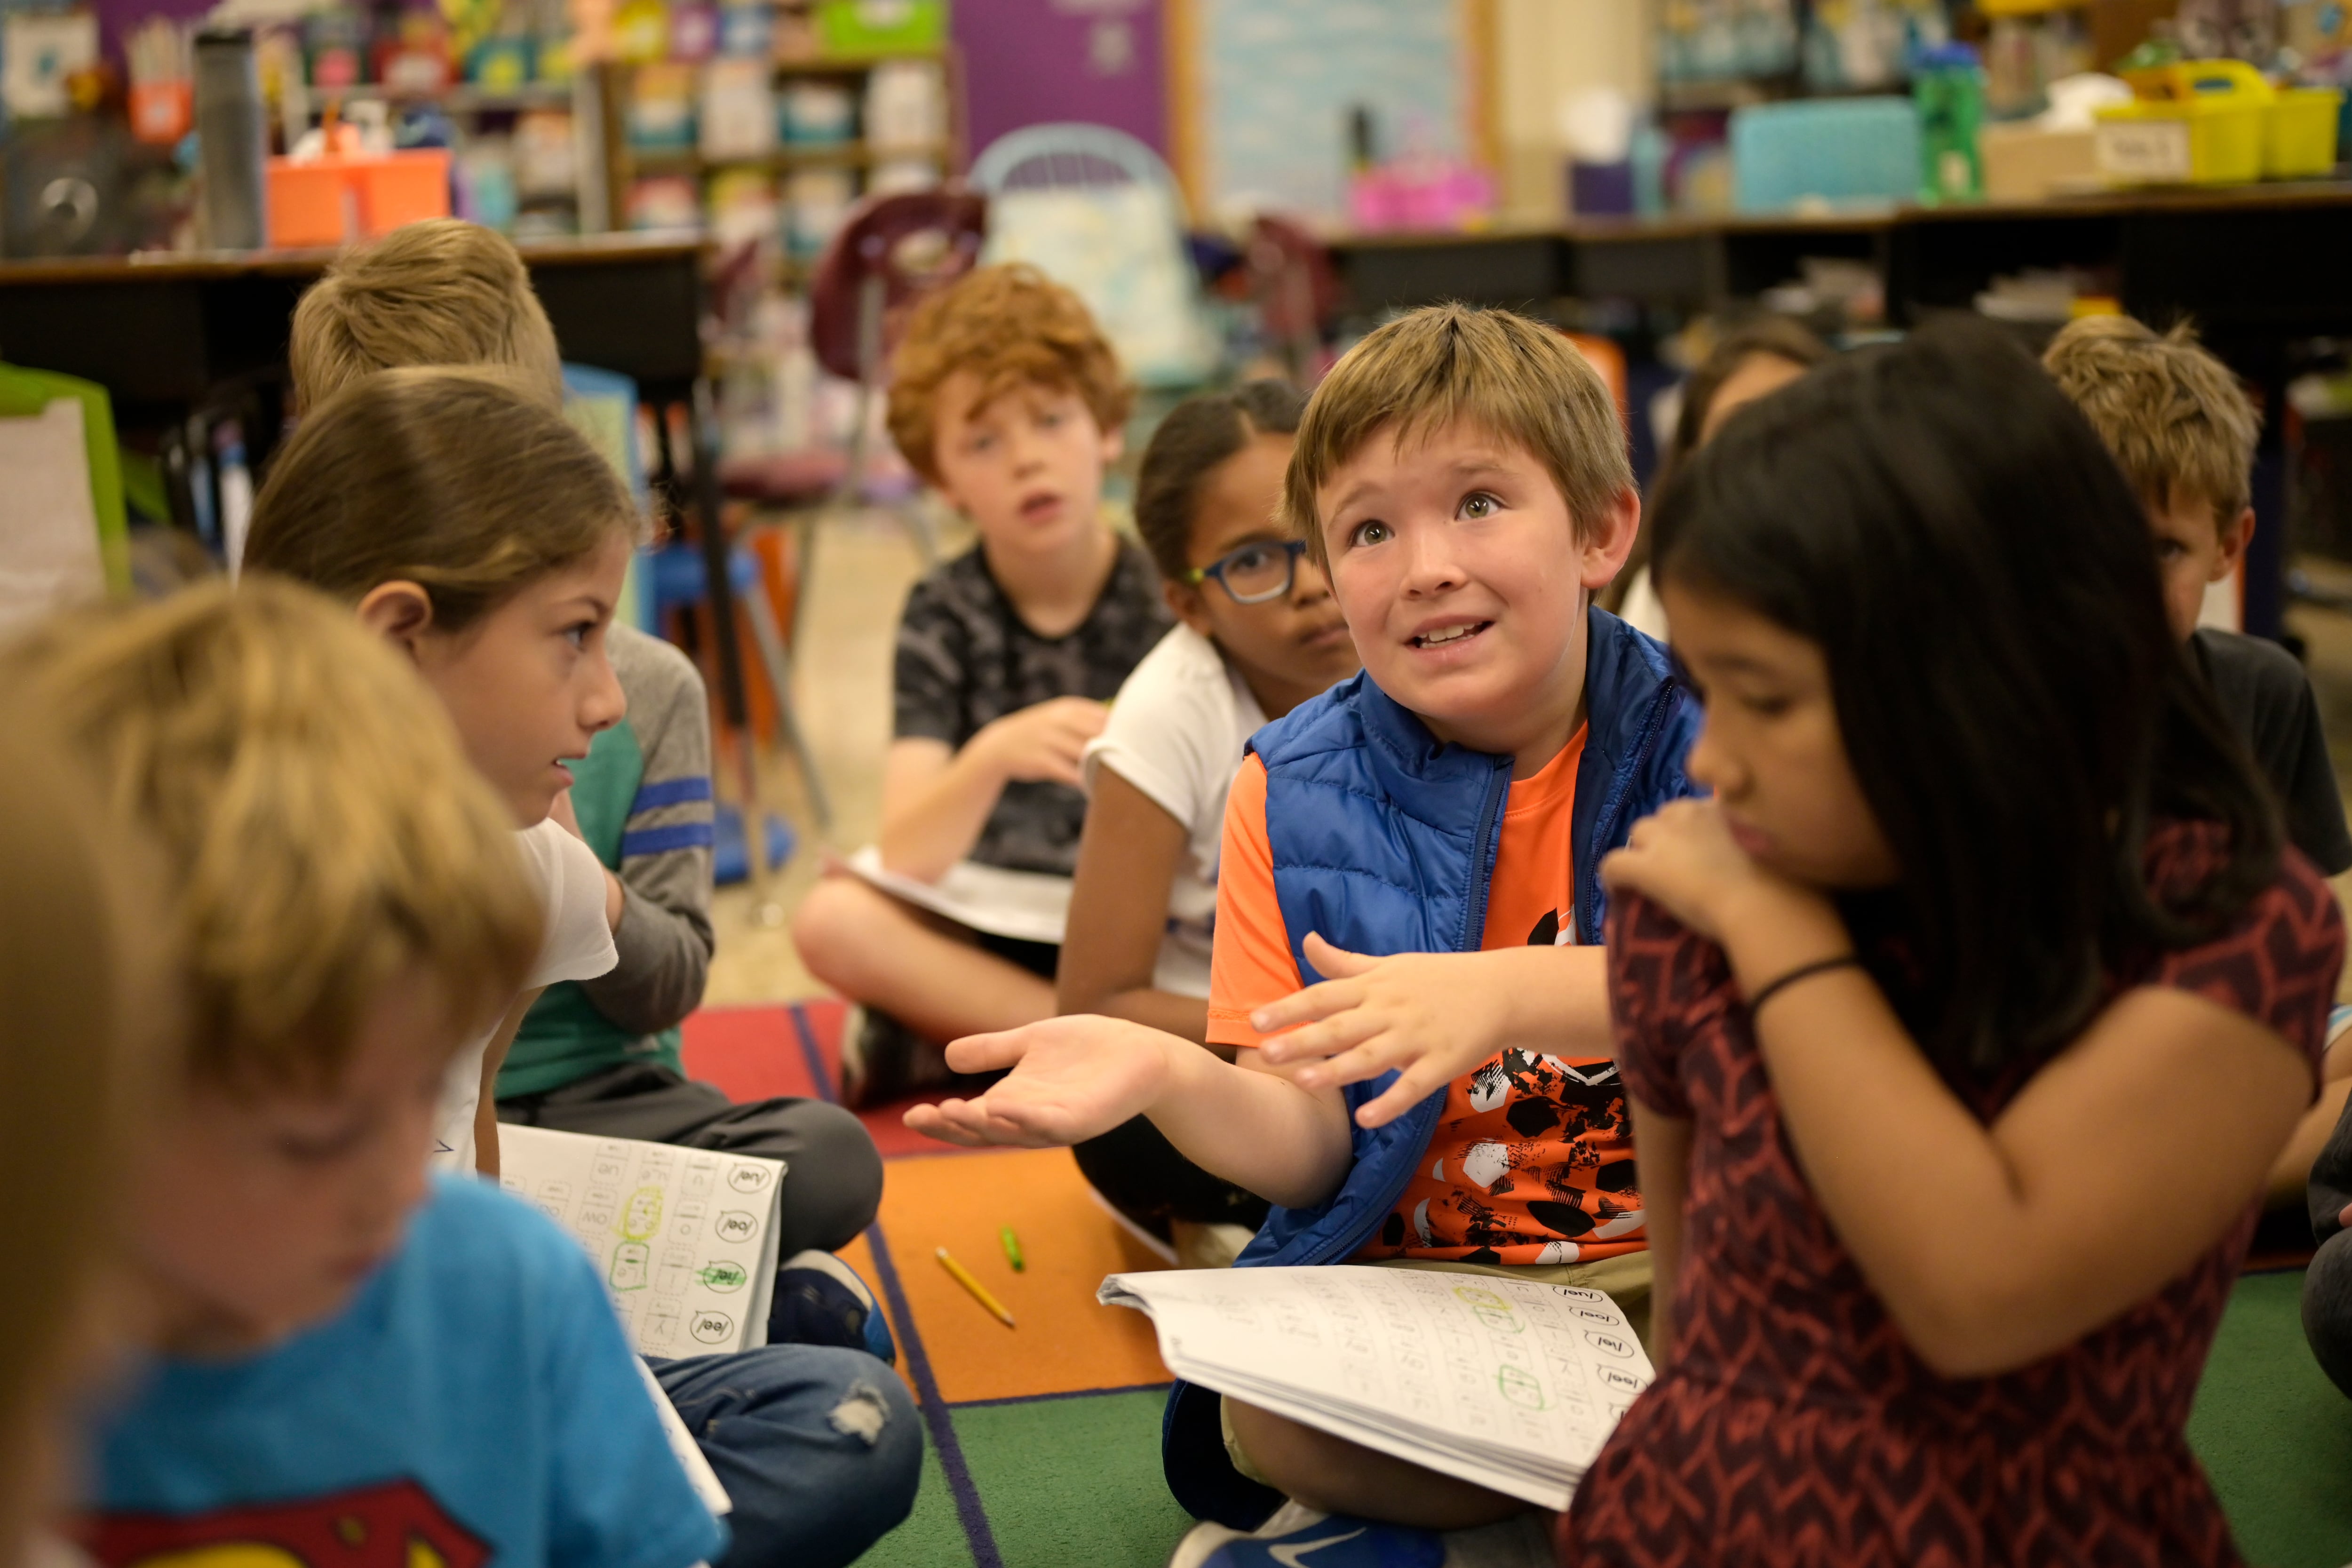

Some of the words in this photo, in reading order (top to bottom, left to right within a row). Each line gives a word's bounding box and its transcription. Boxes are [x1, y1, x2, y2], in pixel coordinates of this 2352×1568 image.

[722, 1219, 753, 1237] /oe/
[1564, 1289, 1593, 1299] /ue/
[1580, 1311, 1609, 1322] /oe/
[696, 1318, 729, 1337] /ee/
